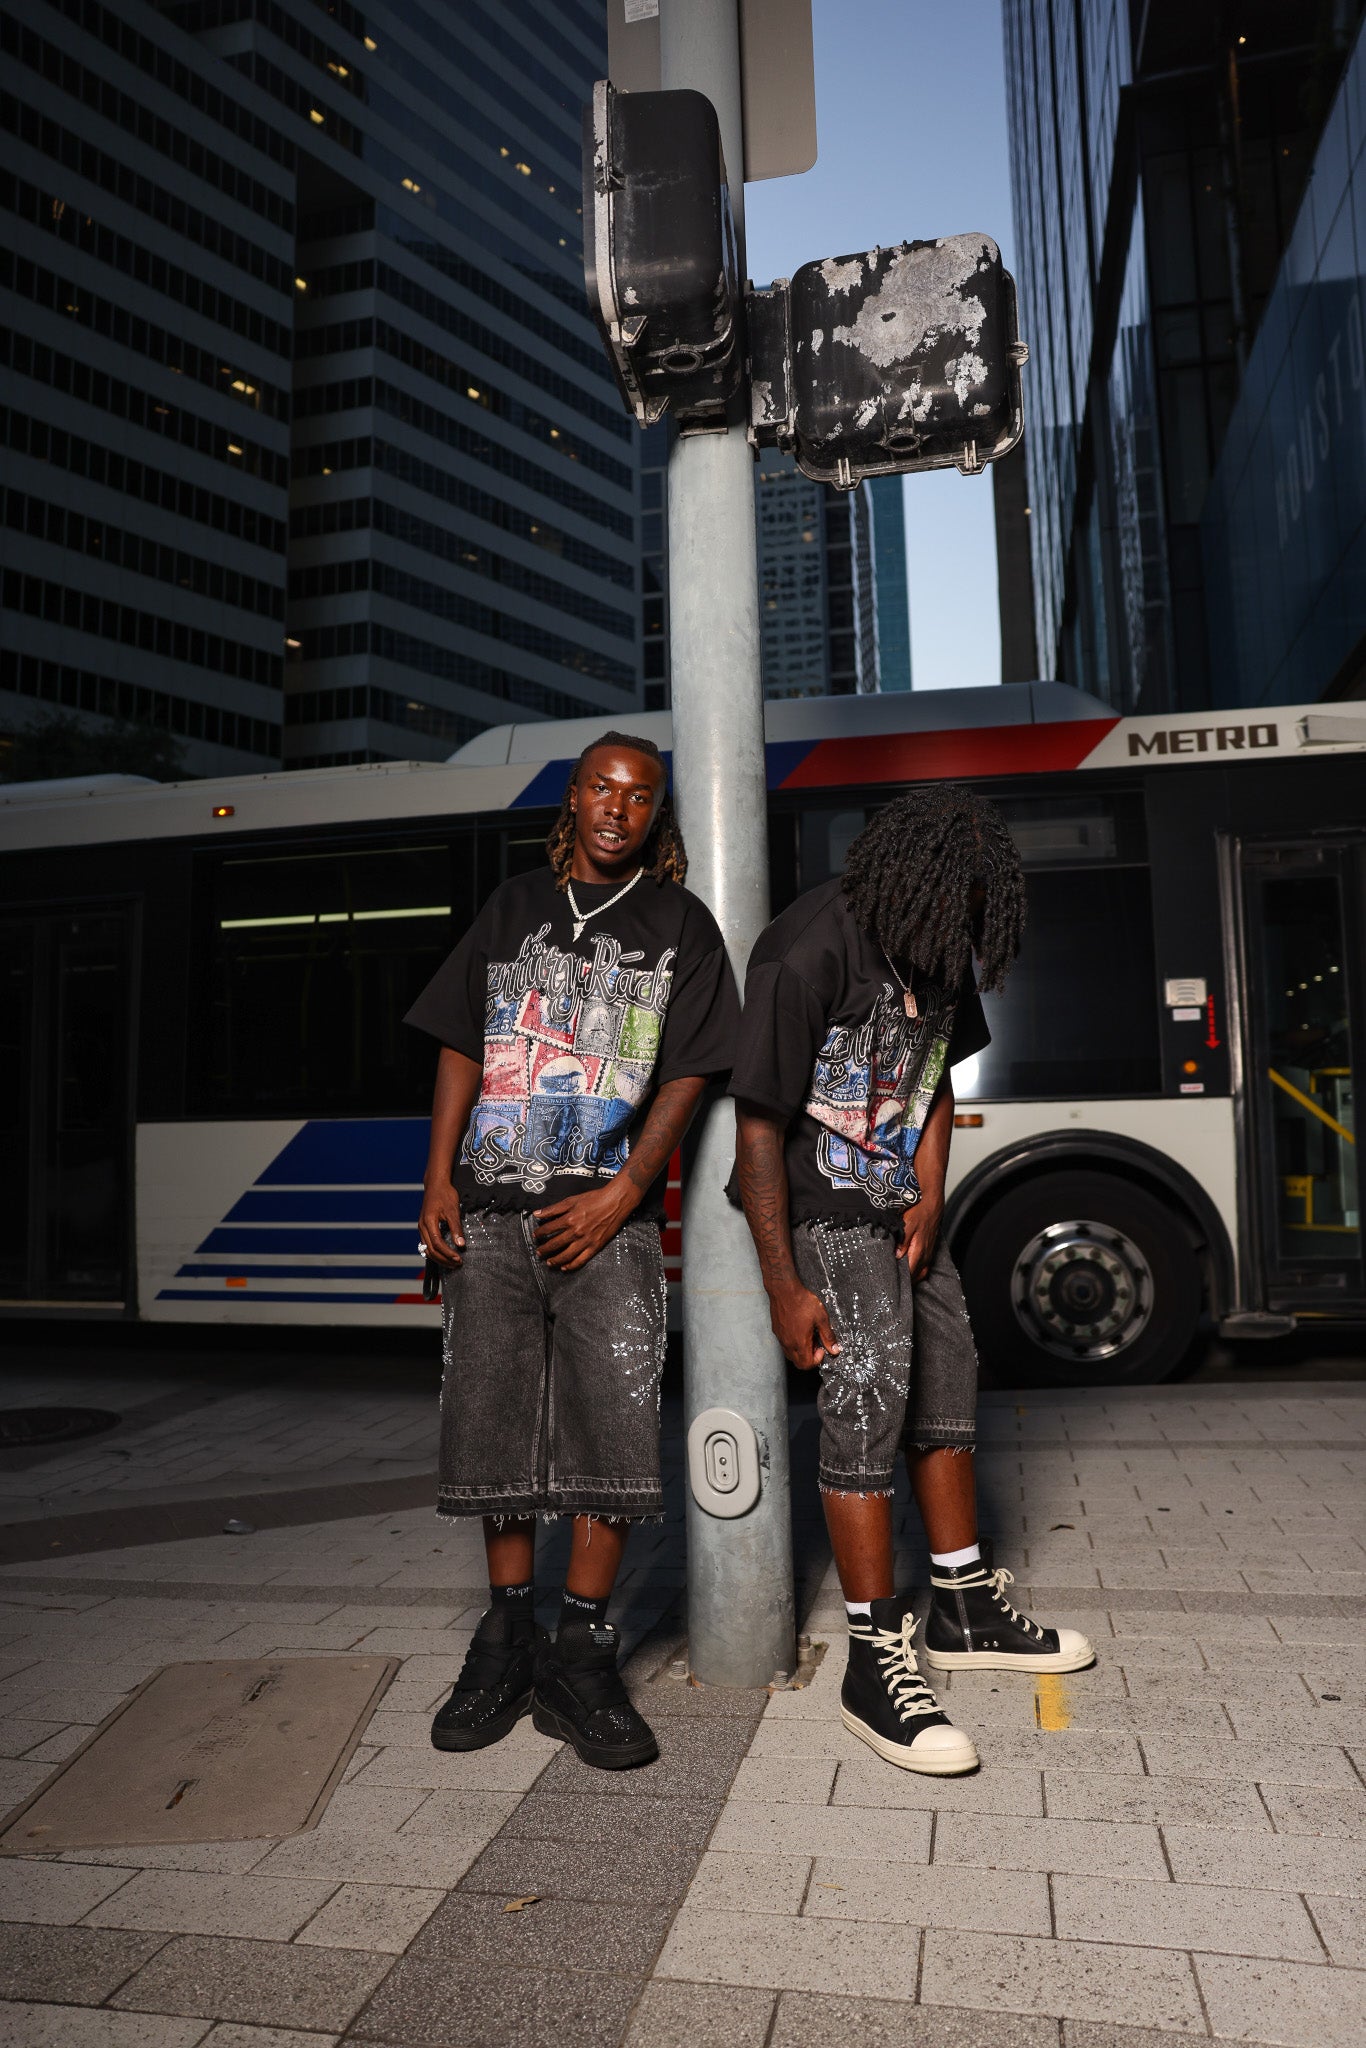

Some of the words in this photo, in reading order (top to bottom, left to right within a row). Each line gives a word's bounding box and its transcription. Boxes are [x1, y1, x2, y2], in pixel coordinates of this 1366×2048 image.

[1128, 723, 1279, 757] METRO
[855, 1084, 865, 1097] 5
[562, 1588, 597, 1610] upreme
